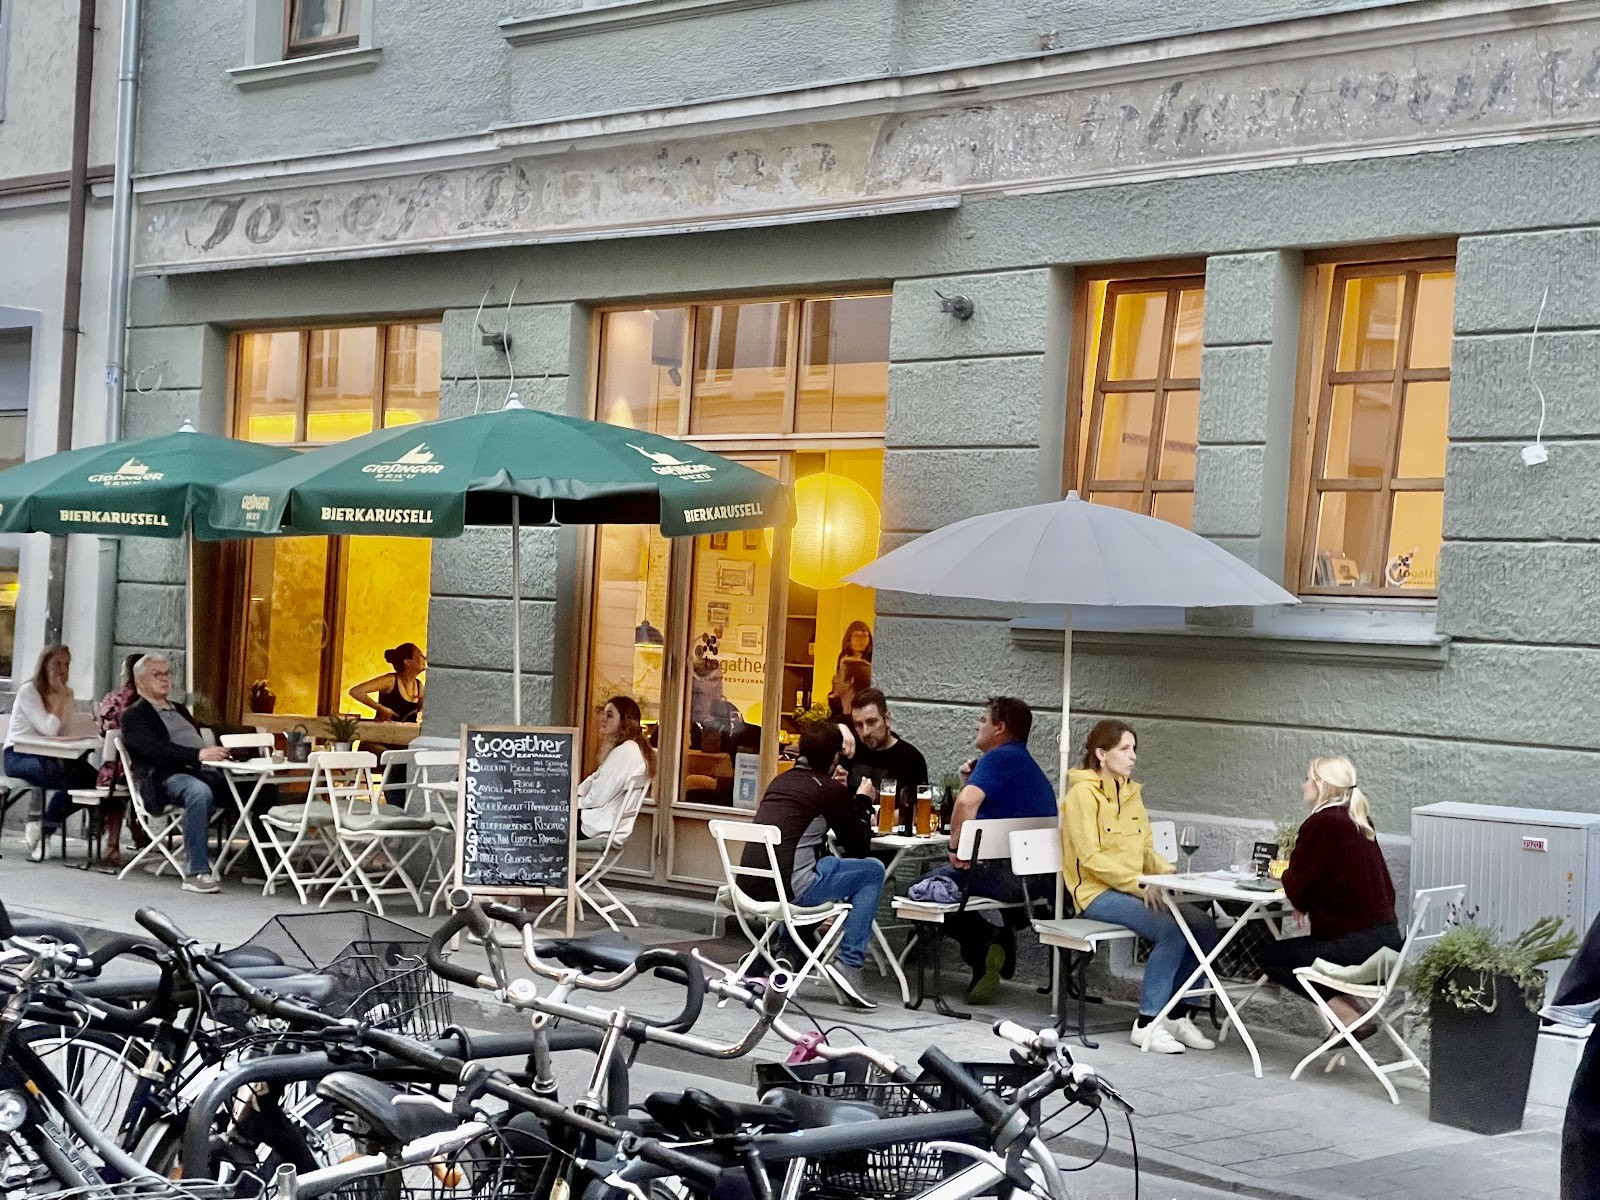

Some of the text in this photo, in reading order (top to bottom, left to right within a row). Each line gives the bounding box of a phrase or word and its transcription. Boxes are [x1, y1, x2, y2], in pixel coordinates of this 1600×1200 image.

[59, 509, 169, 527] BIERKARUSSELL
[321, 506, 434, 524] BIERKARUSSELL
[684, 502, 763, 523] BIERKARUSSELL
[471, 733, 566, 758] togather
